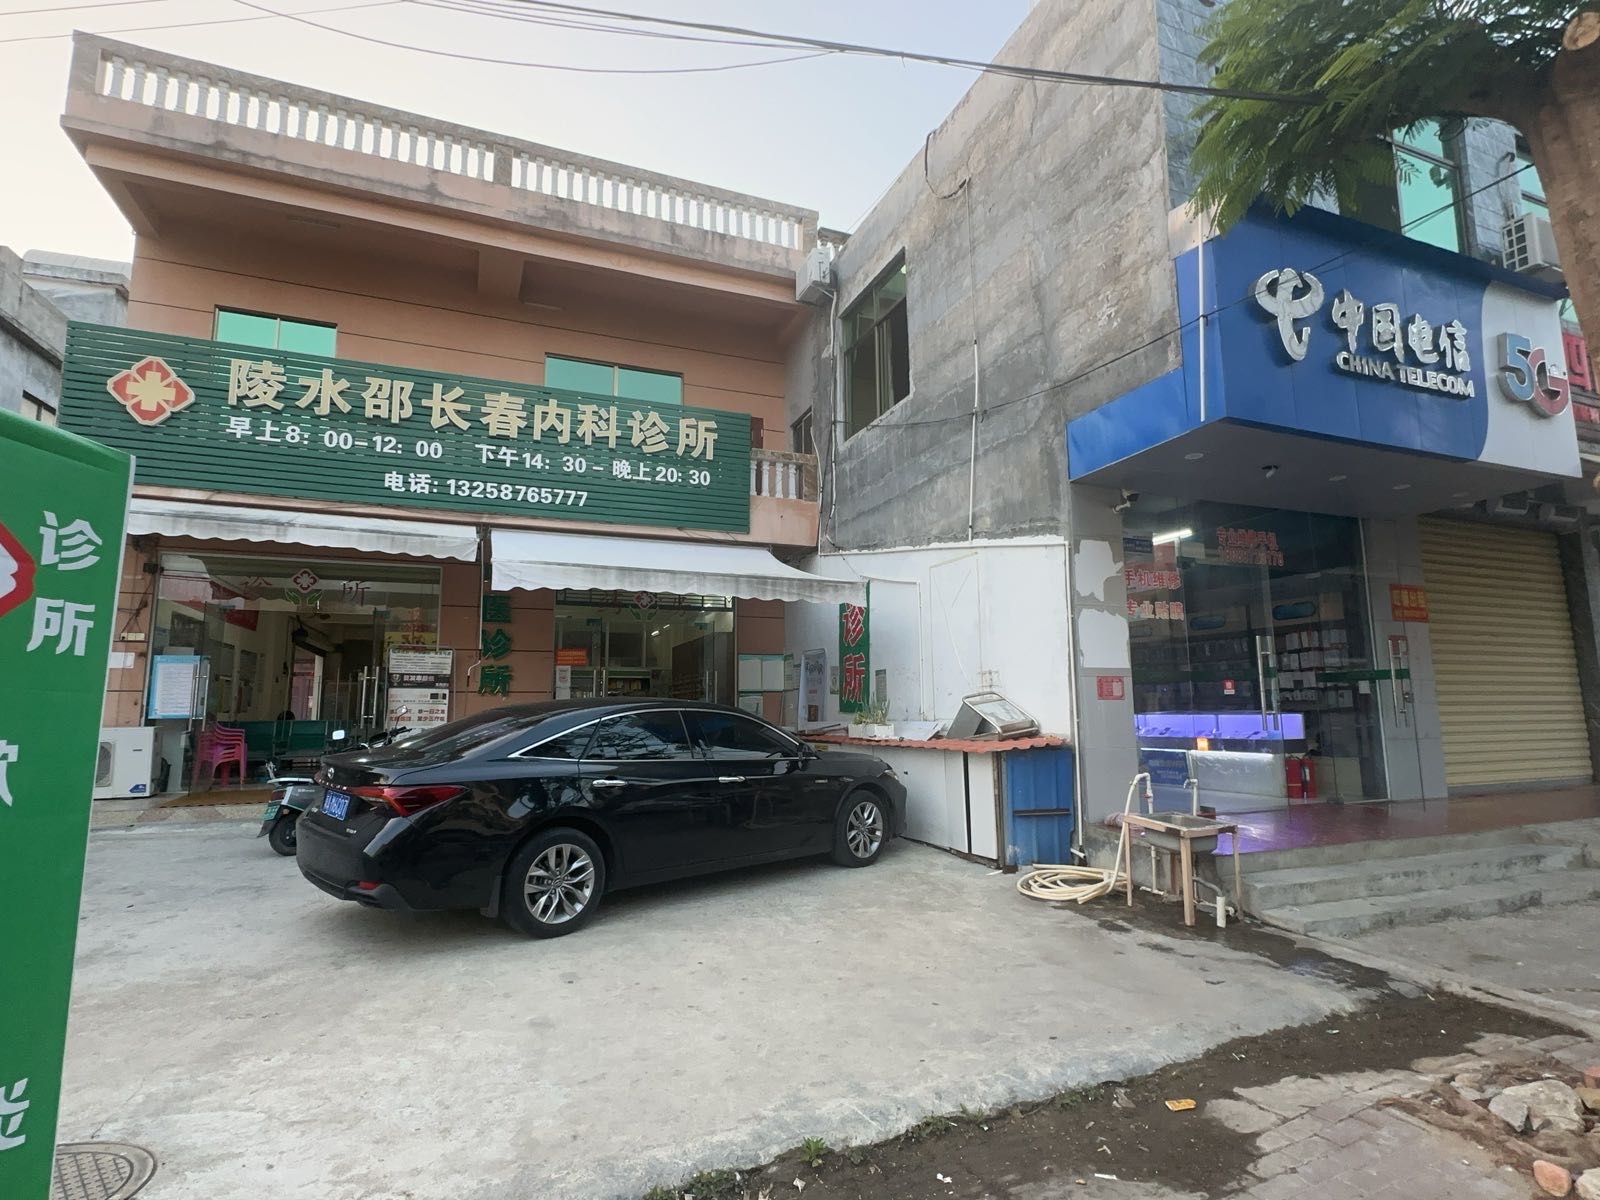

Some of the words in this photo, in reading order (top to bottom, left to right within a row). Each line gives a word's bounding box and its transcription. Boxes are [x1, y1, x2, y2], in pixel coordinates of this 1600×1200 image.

[1332, 288, 1471, 372] 中国电信
[1336, 351, 1396, 381] CHINA
[1396, 364, 1475, 398] TELECOM
[1498, 331, 1570, 419] 5G
[227, 358, 719, 462] 陵水邵长春内科诊所
[26, 510, 103, 657] 诊所
[842, 602, 865, 703] 诊所
